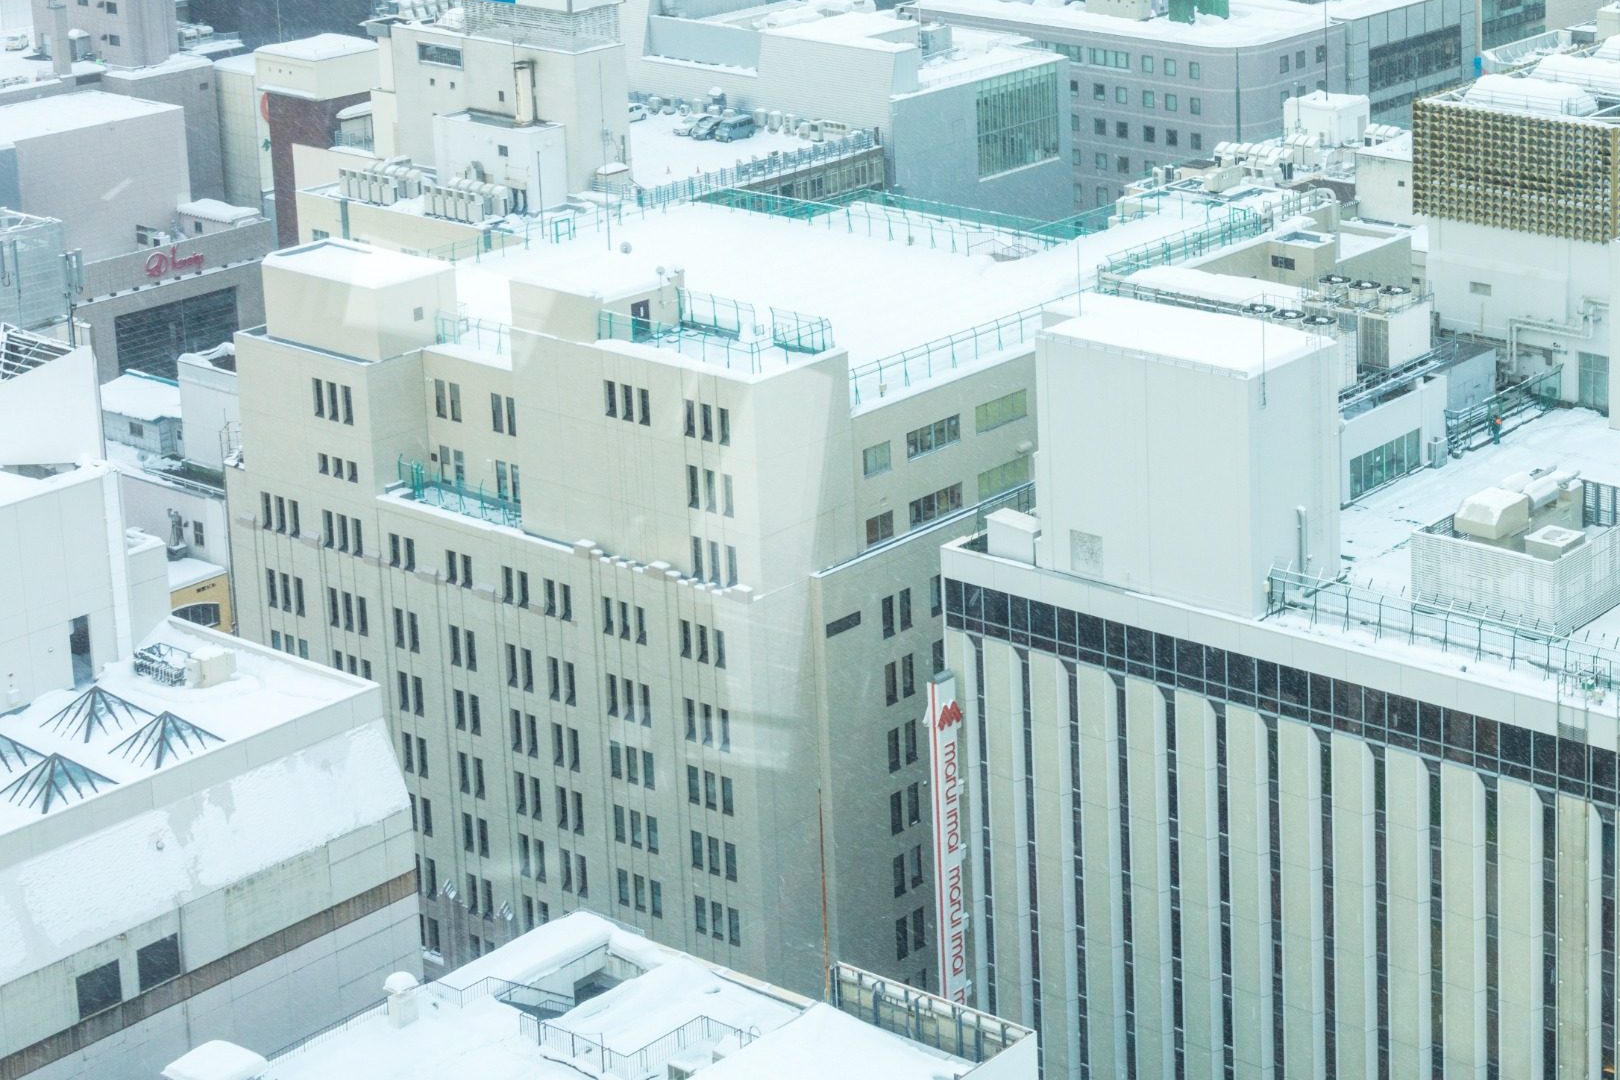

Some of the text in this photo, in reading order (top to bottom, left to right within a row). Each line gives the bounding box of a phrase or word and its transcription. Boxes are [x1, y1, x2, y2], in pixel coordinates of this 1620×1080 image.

[943, 741, 960, 854] marui imai
[947, 864, 962, 925] marui
[951, 928, 965, 975] imai
